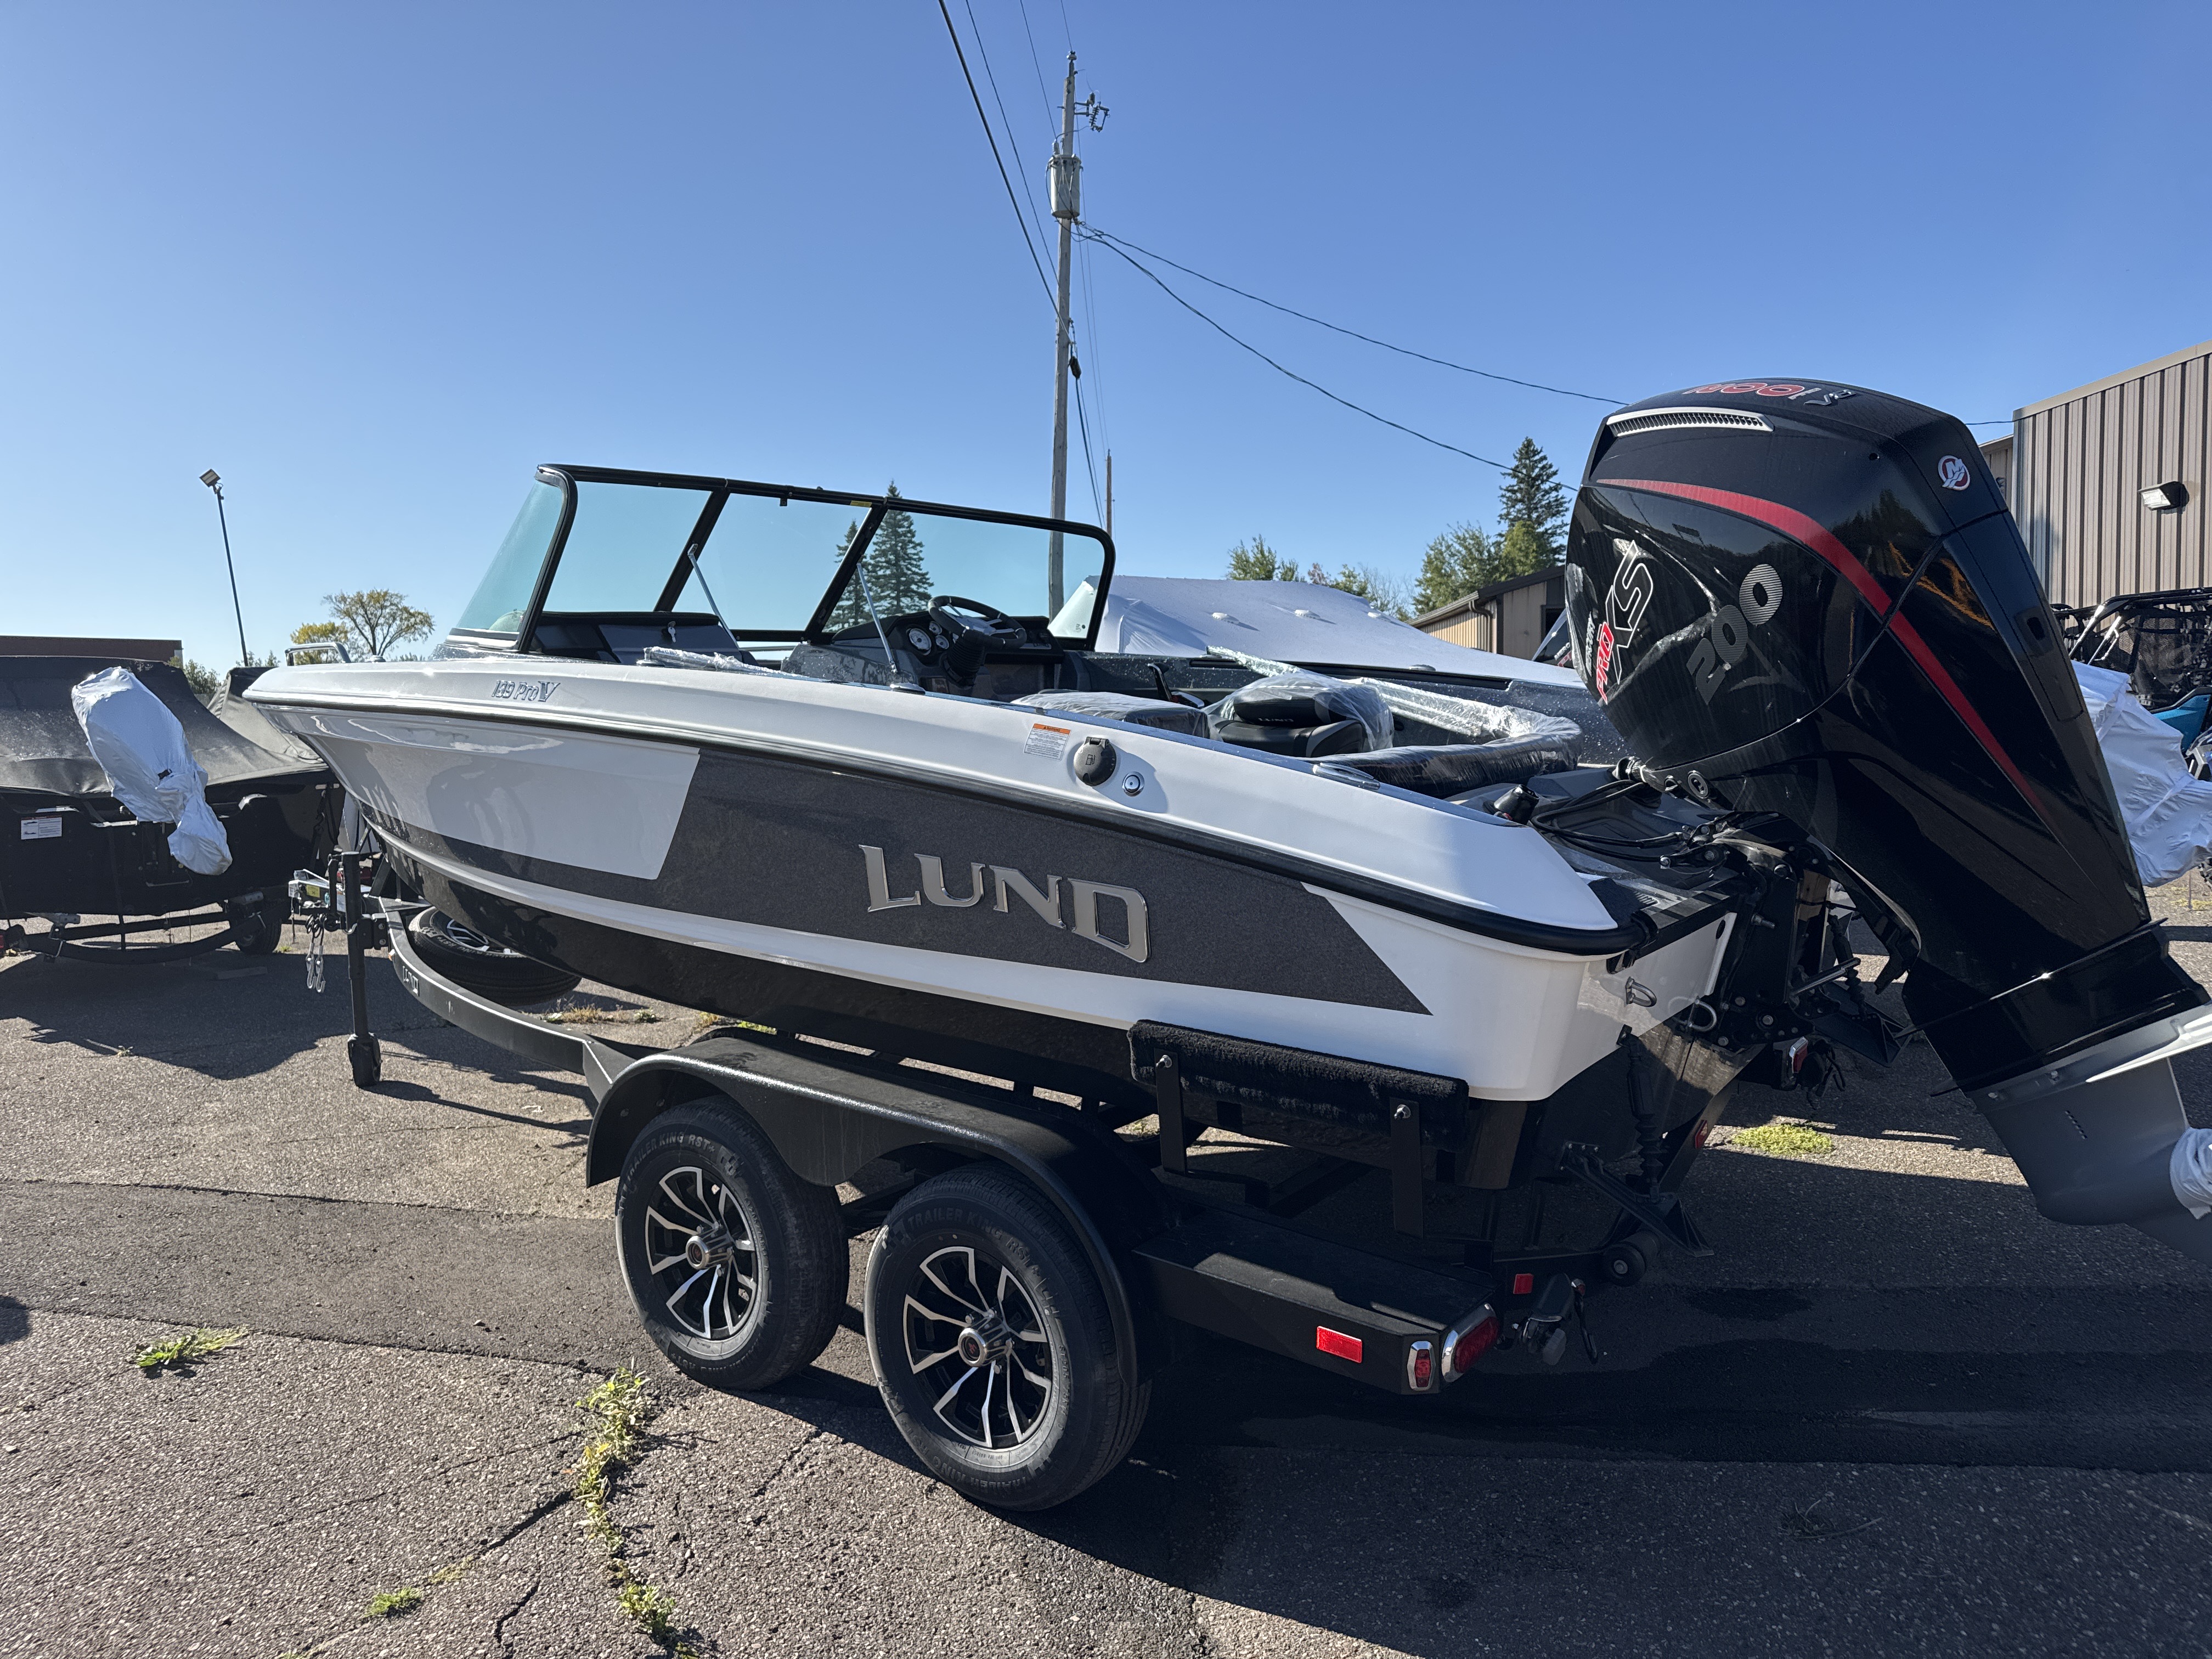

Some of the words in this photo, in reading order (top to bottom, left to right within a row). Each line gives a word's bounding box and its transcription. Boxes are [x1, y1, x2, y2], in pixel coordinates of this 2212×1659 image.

[1596, 621, 1615, 706] PRO
[1605, 540, 1654, 685] XS
[1686, 563, 1783, 706] 200
[858, 844, 1151, 963] LUND
[659, 1131, 686, 1147] KING
[907, 1207, 963, 1230] TRAILER
[966, 1211, 1005, 1240] KING
